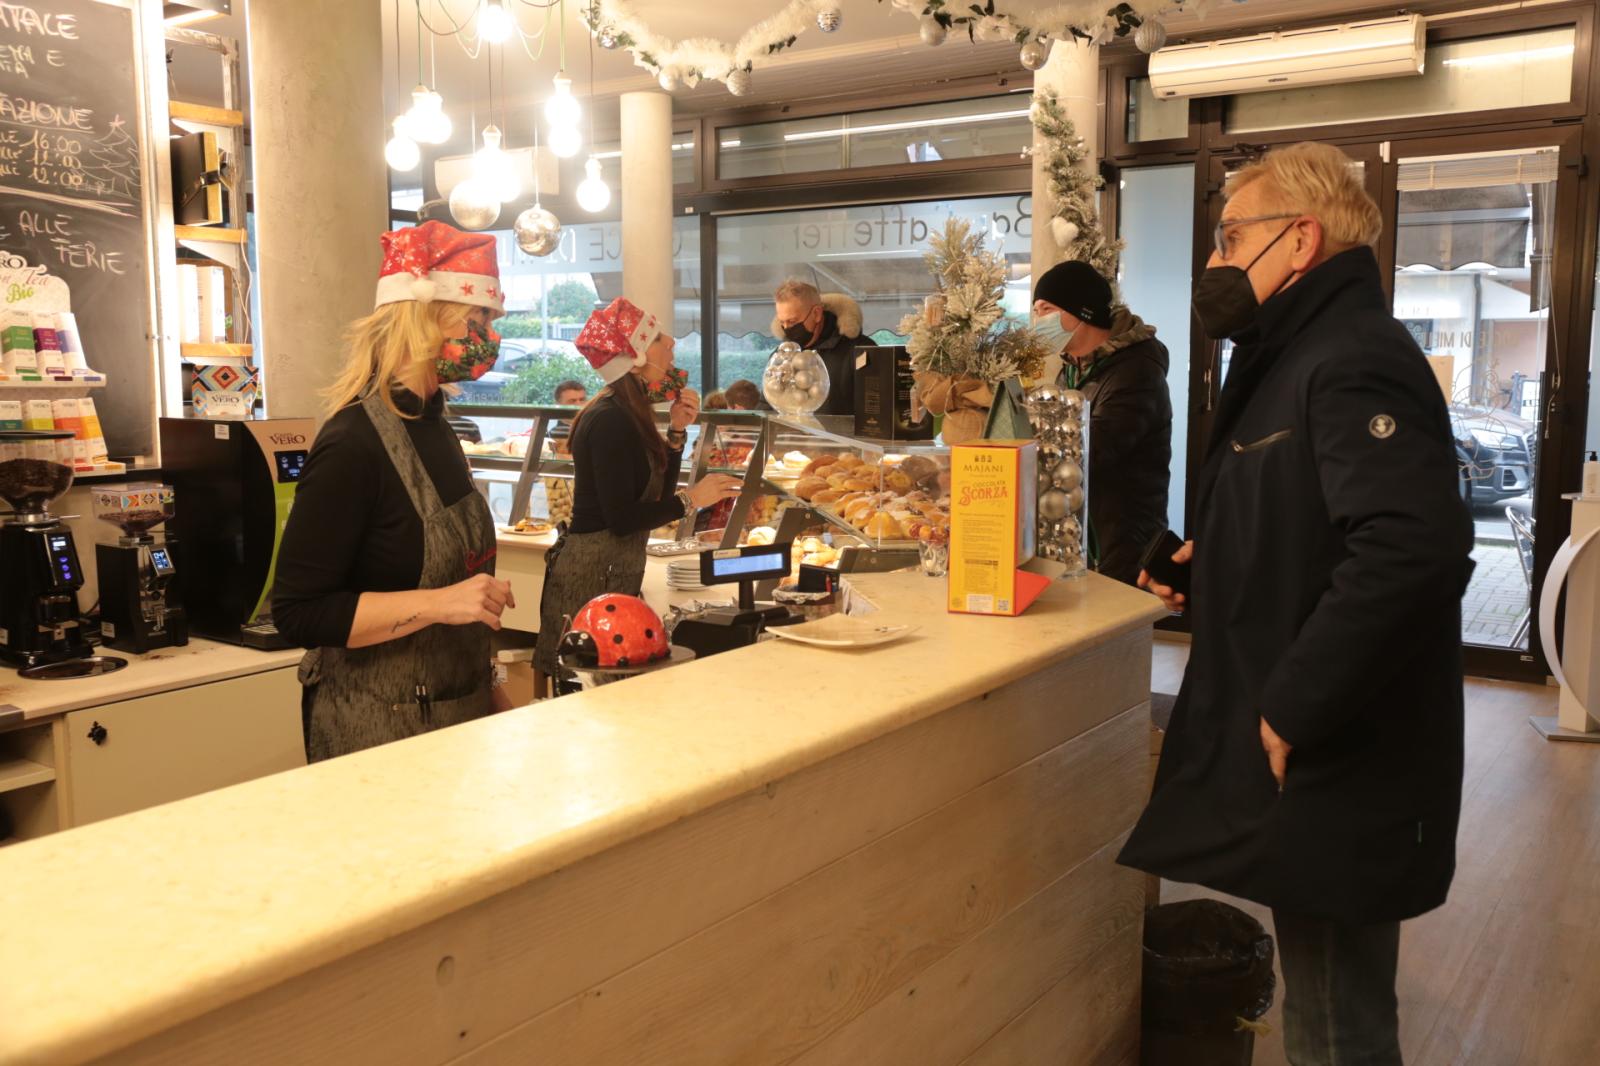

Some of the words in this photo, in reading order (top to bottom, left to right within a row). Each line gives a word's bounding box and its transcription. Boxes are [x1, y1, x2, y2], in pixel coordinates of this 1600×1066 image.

[0, 92, 94, 130] AZIONE
[19, 210, 72, 237] ALLE
[6, 282, 35, 303] Bio
[269, 434, 306, 445] VERO
